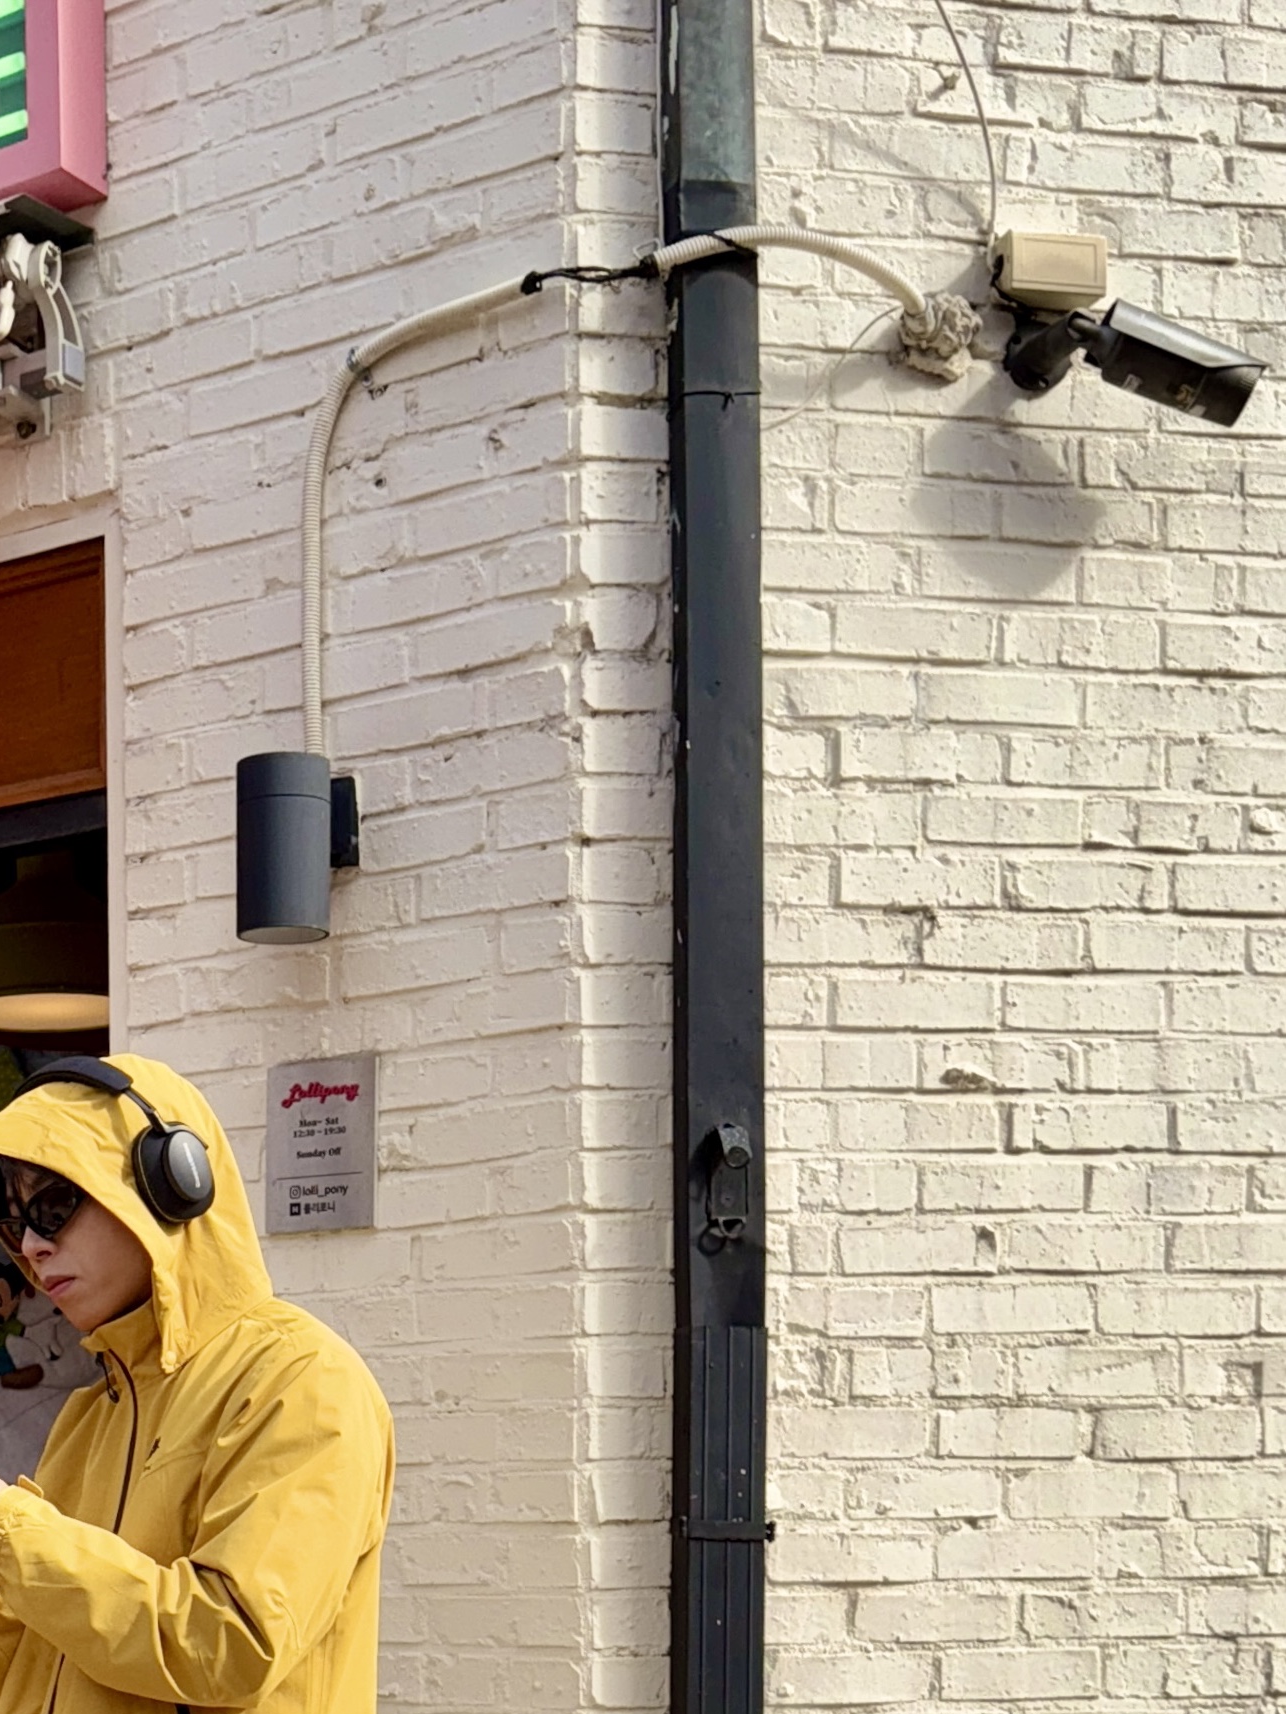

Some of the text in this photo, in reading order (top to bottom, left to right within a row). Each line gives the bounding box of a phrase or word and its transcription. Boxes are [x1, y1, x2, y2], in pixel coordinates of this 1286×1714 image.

[281, 1081, 360, 1109] Lollipony
[325, 1116, 339, 1126] Sat
[296, 1146, 342, 1159] Sunday Off
